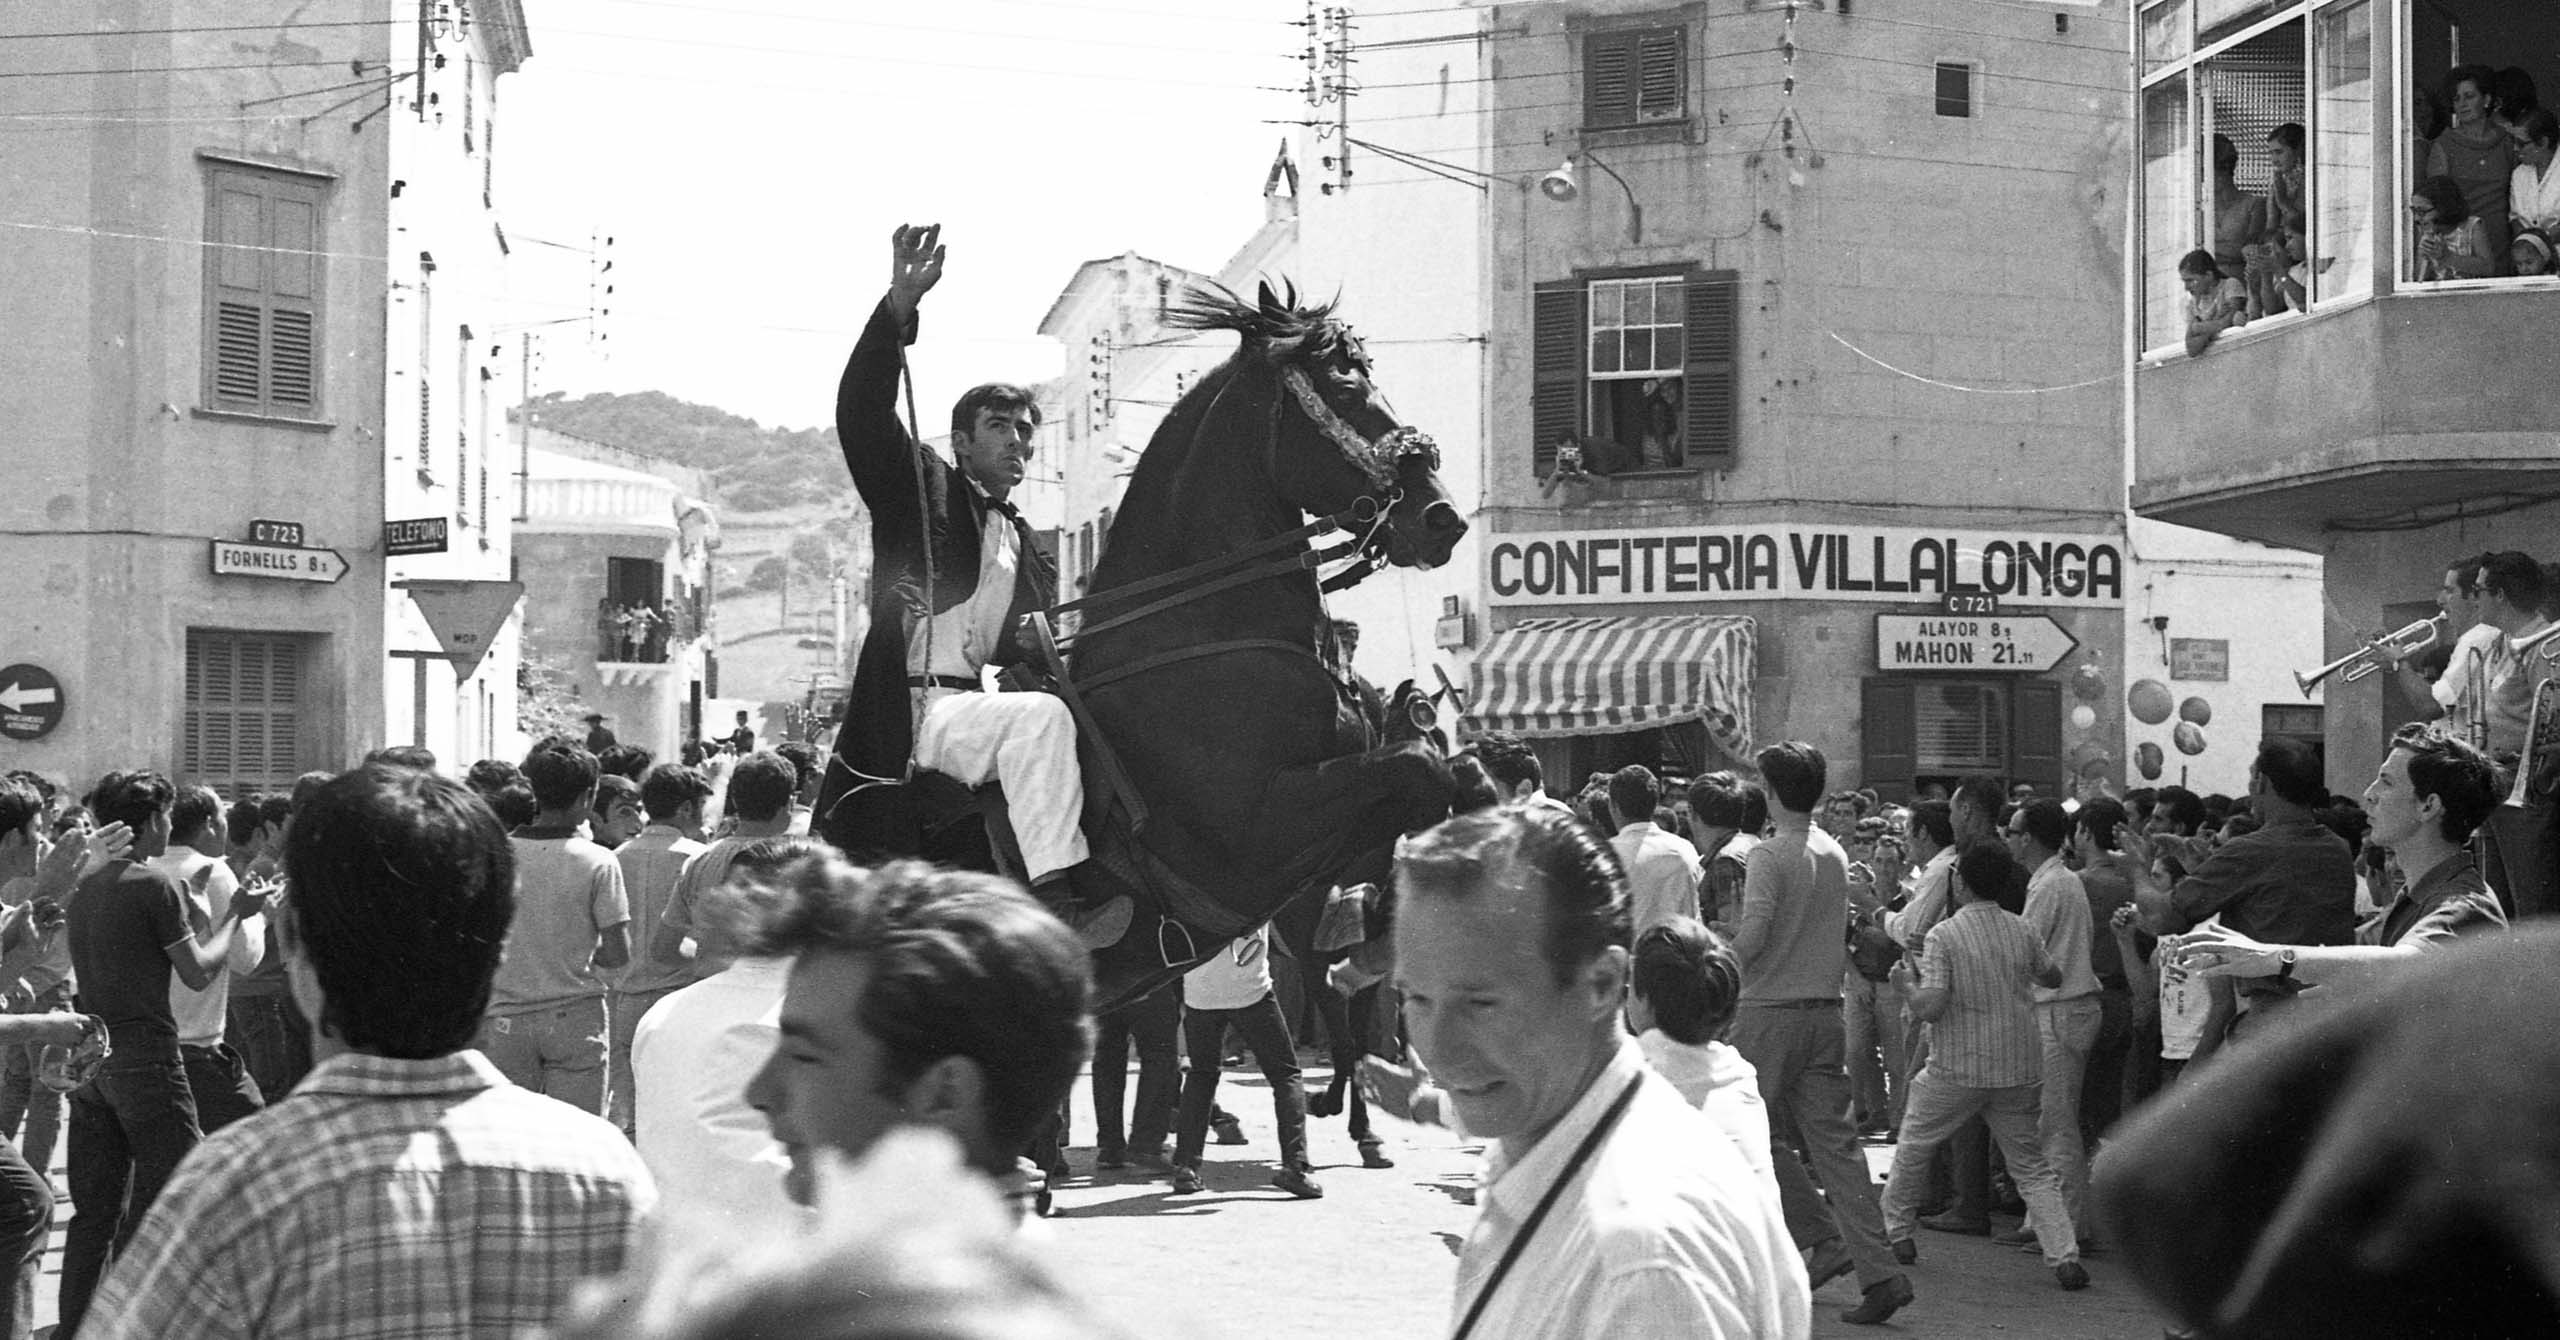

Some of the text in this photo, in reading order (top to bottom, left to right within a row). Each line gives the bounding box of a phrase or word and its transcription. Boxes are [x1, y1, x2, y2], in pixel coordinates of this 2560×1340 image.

[256, 524, 299, 543] C 723
[386, 520, 445, 544] TELEFONO
[223, 549, 297, 570] FORNELLS
[1491, 533, 2121, 599] CONFITERIA VILLALONGA
[1950, 597, 1993, 612] C 721
[1919, 622, 1978, 637] ALAYOR
[1896, 642, 1973, 664] MAHON
